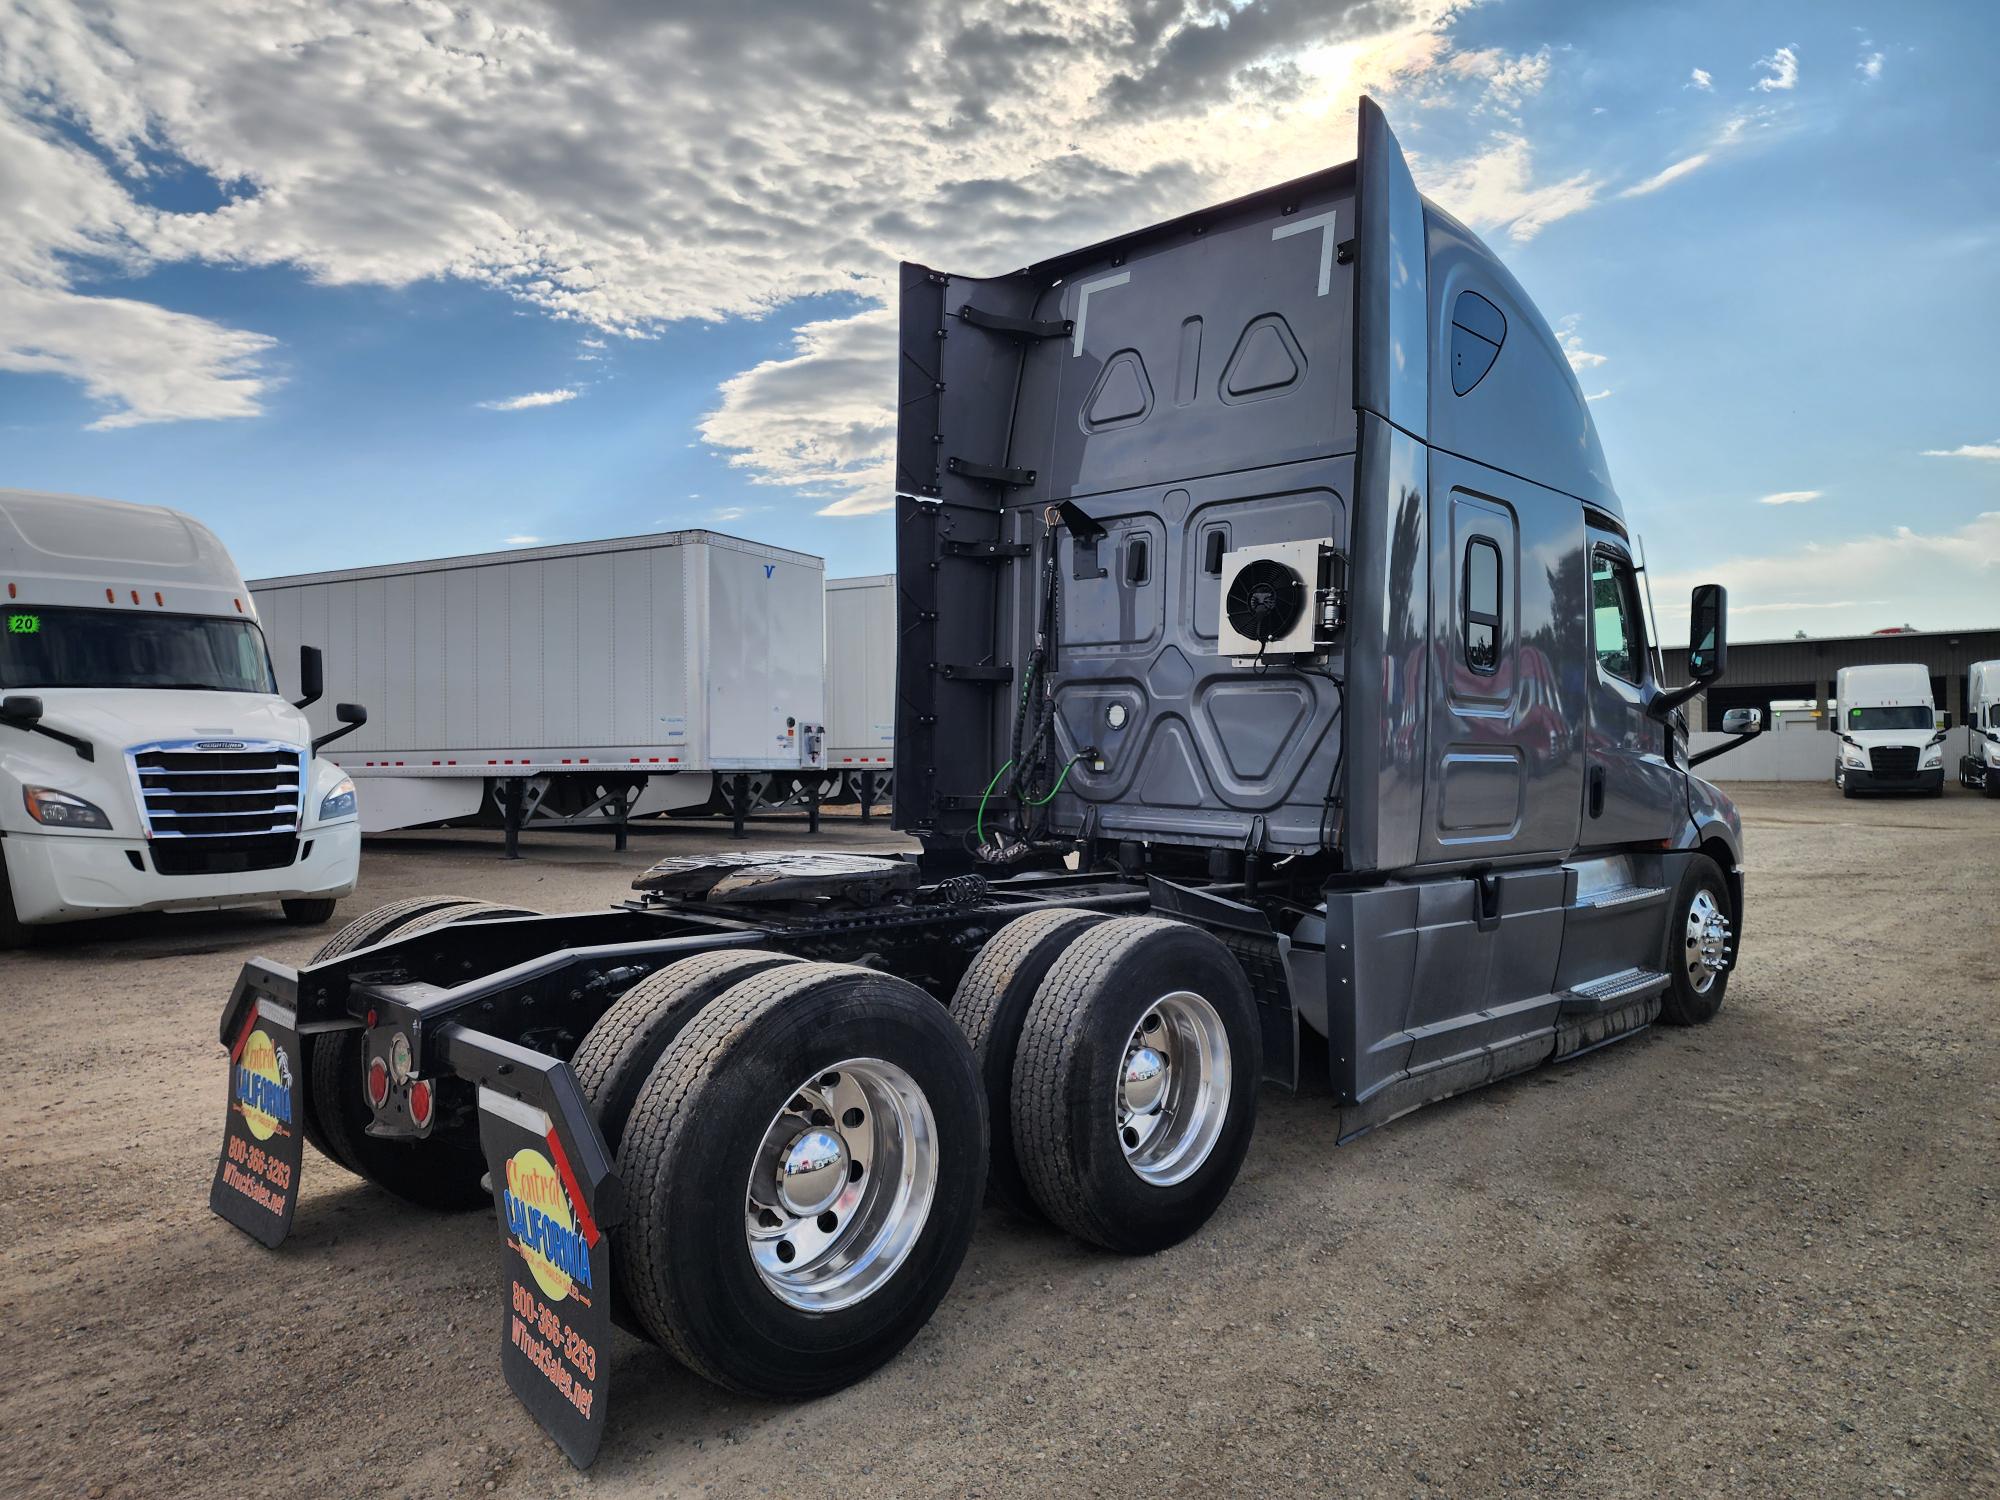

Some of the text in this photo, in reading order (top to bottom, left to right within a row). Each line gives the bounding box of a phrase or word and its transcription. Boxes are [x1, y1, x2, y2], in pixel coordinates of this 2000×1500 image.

[15, 618, 33, 630] 20
[236, 1064, 292, 1124] CALIFORNIA
[228, 1135, 291, 1190] 800-366-3263
[506, 1158, 563, 1211] Central
[504, 1189, 593, 1290] CALIFORNIA
[512, 1280, 596, 1381] 800-366-3263
